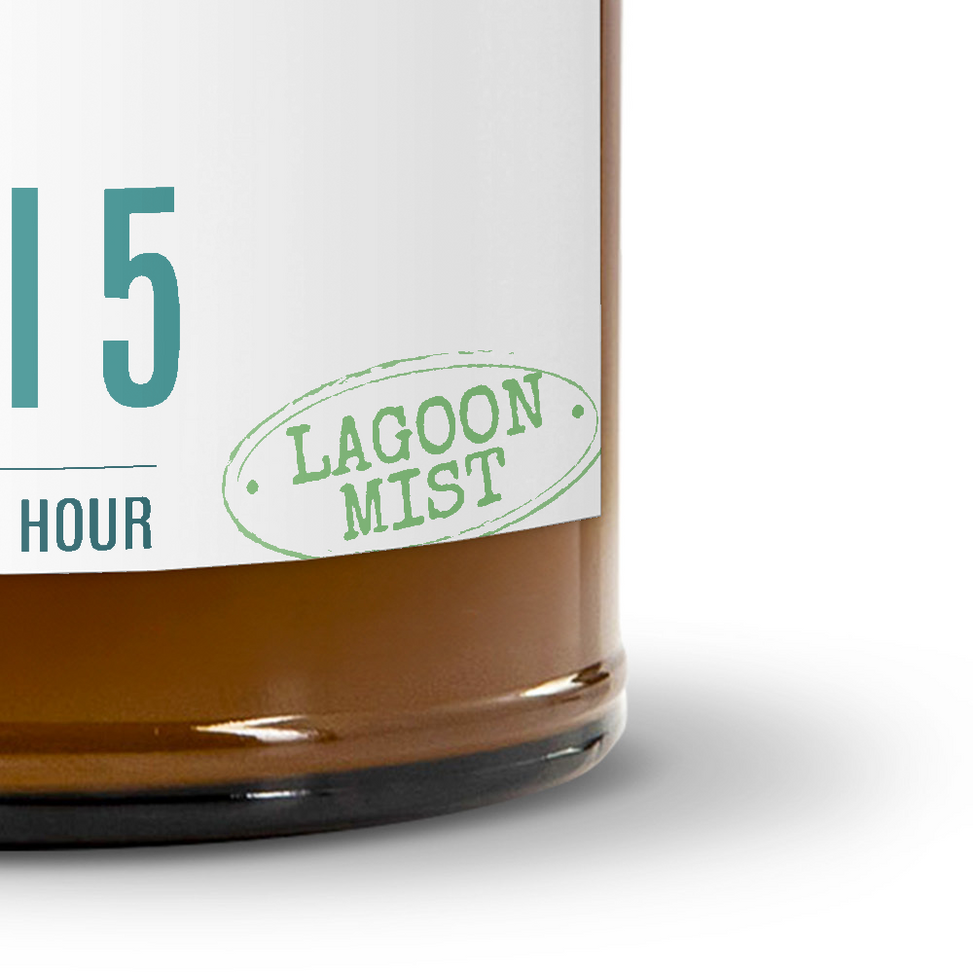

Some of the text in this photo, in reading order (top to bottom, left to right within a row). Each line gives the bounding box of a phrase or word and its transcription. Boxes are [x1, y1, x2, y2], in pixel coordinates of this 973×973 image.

[103, 187, 180, 408] 5
[286, 371, 543, 485] LAGOON
[22, 497, 152, 552] HOUR
[339, 447, 506, 541] MIST
